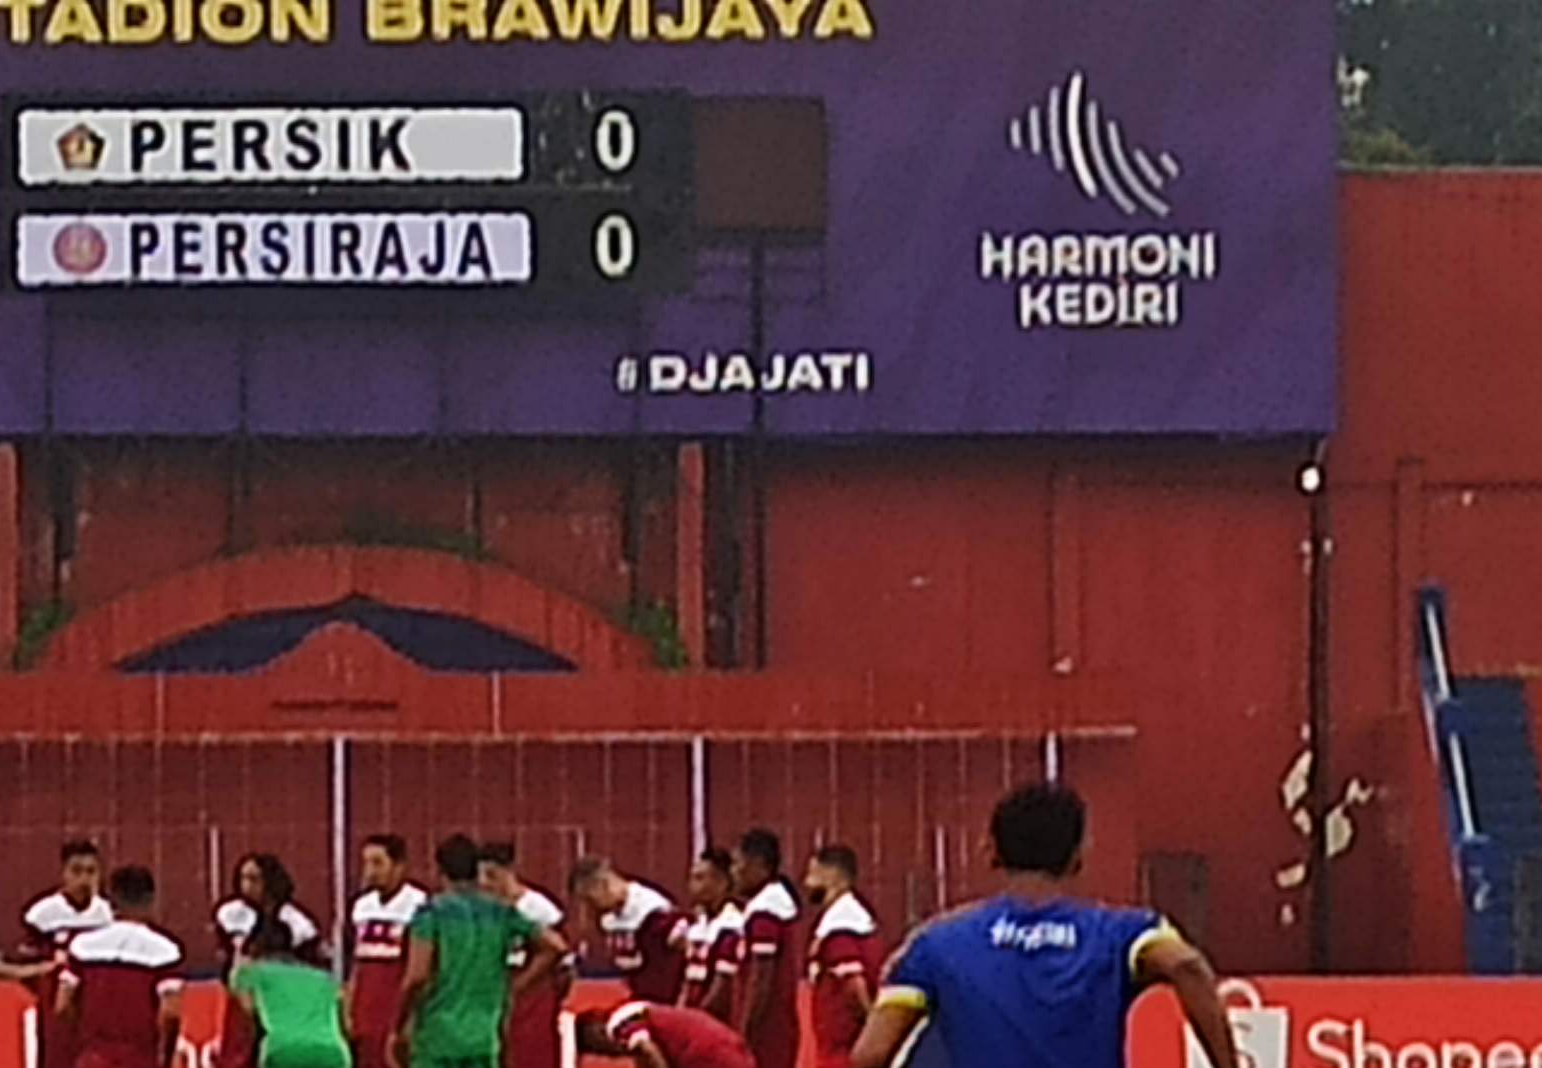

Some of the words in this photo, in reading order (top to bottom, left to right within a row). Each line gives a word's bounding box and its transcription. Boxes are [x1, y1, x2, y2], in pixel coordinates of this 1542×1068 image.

[365, 0, 874, 42] BRAWIJAYA
[128, 118, 411, 173] PERSIK
[595, 110, 634, 171] 0
[129, 220, 494, 277] PERSIRAJA
[595, 213, 634, 277] 0
[981, 231, 1215, 280] HARMONI
[1020, 279, 1178, 328] KEDIRI
